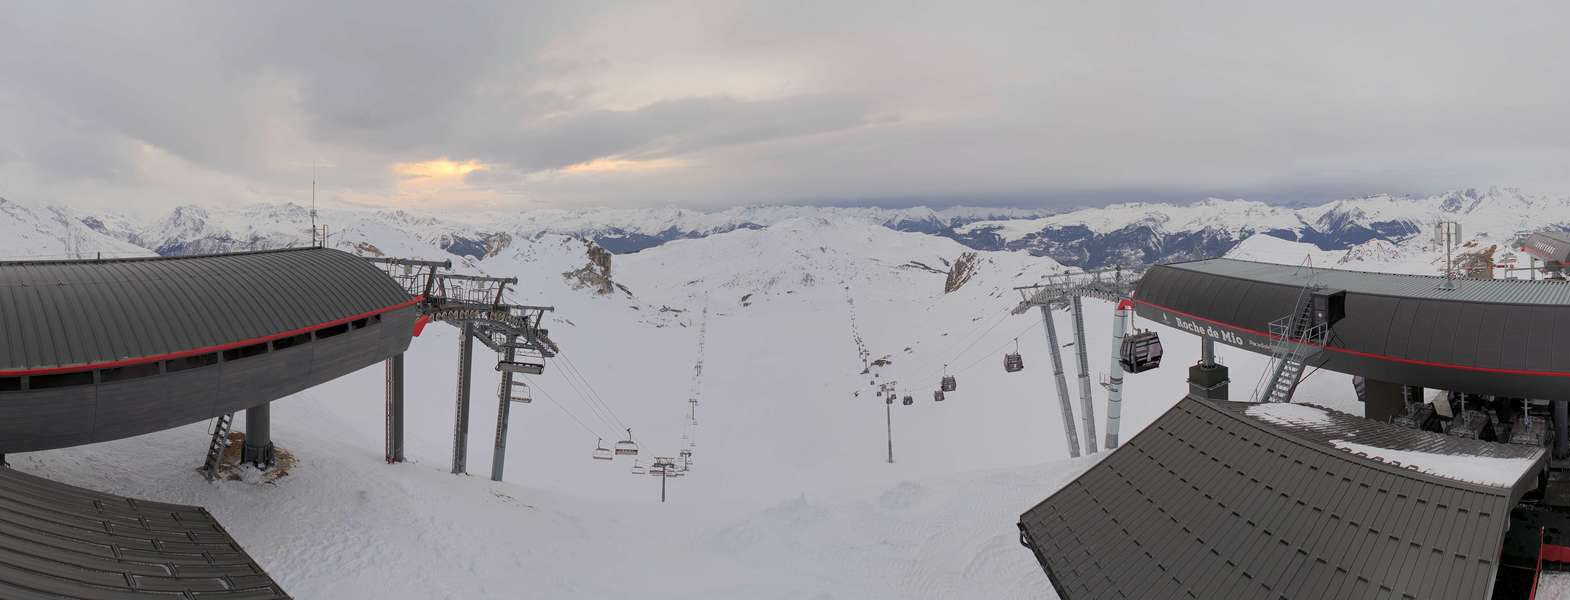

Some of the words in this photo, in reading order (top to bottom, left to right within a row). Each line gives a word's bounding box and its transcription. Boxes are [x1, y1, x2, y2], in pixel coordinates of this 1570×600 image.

[1176, 317, 1205, 335] Roche
[1207, 326, 1219, 339] de
[1221, 330, 1243, 345] Mio
